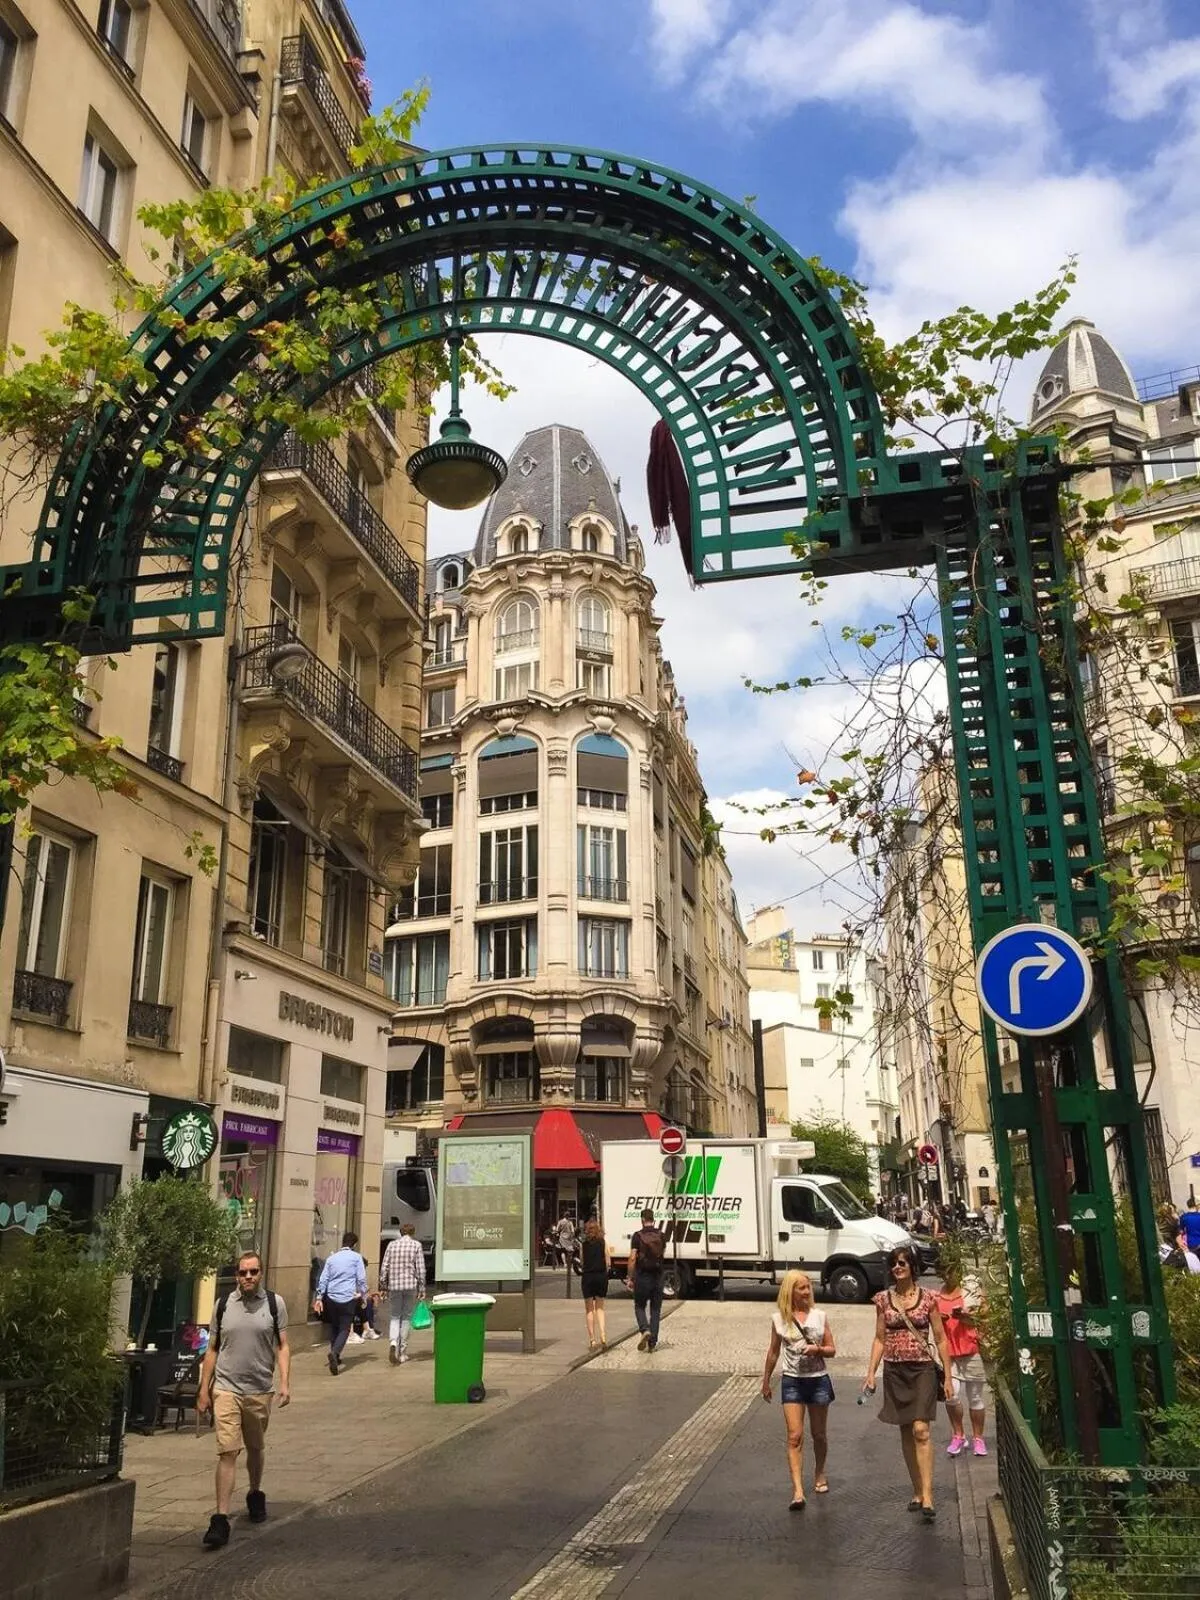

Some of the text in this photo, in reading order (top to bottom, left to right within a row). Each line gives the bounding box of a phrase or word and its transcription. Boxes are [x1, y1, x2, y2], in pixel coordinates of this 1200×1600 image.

[279, 990, 354, 1041] BRIGHTON
[626, 1196, 743, 1211] PETIT FORESTIER
